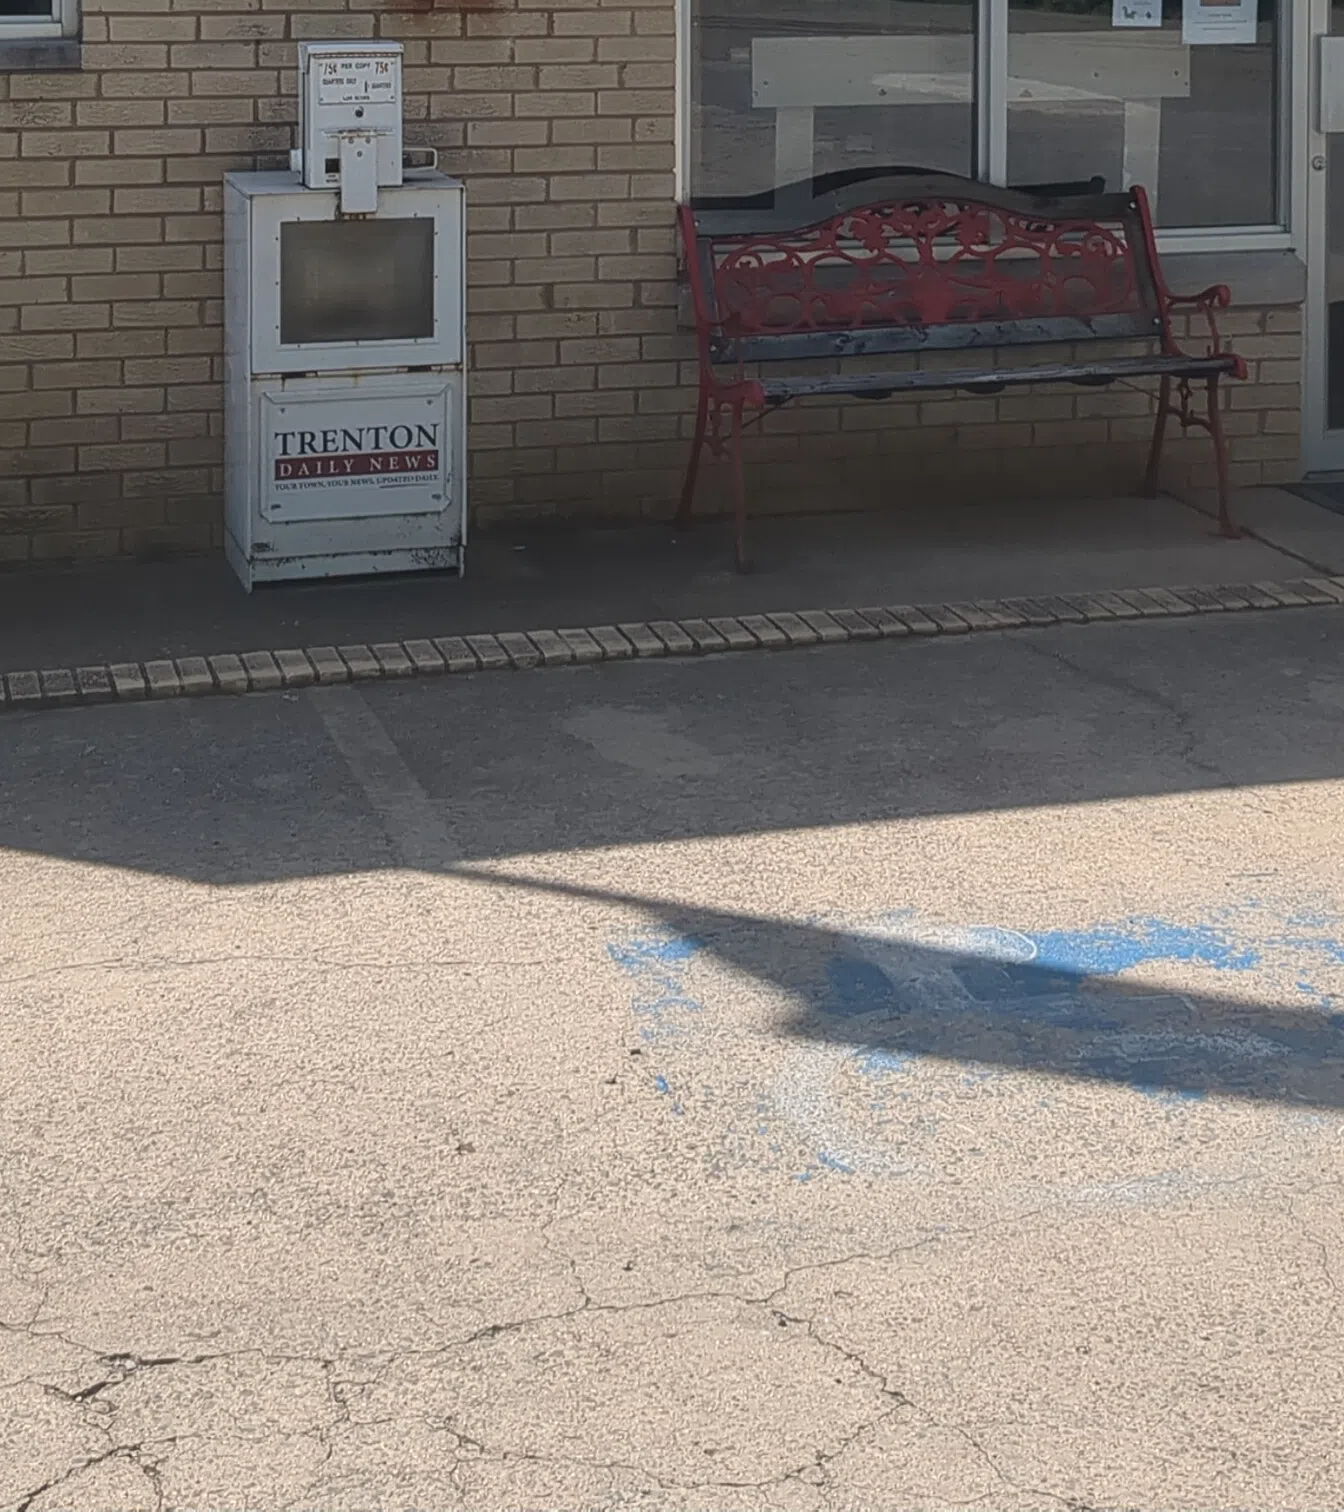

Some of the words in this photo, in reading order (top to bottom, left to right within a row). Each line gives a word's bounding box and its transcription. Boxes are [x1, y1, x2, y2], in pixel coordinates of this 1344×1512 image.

[274, 423, 440, 456] TRENTON
[279, 459, 355, 477] DAILY
[369, 454, 437, 471] NEWS
[275, 482, 298, 491] YOUR
[327, 479, 349, 487] YOUR
